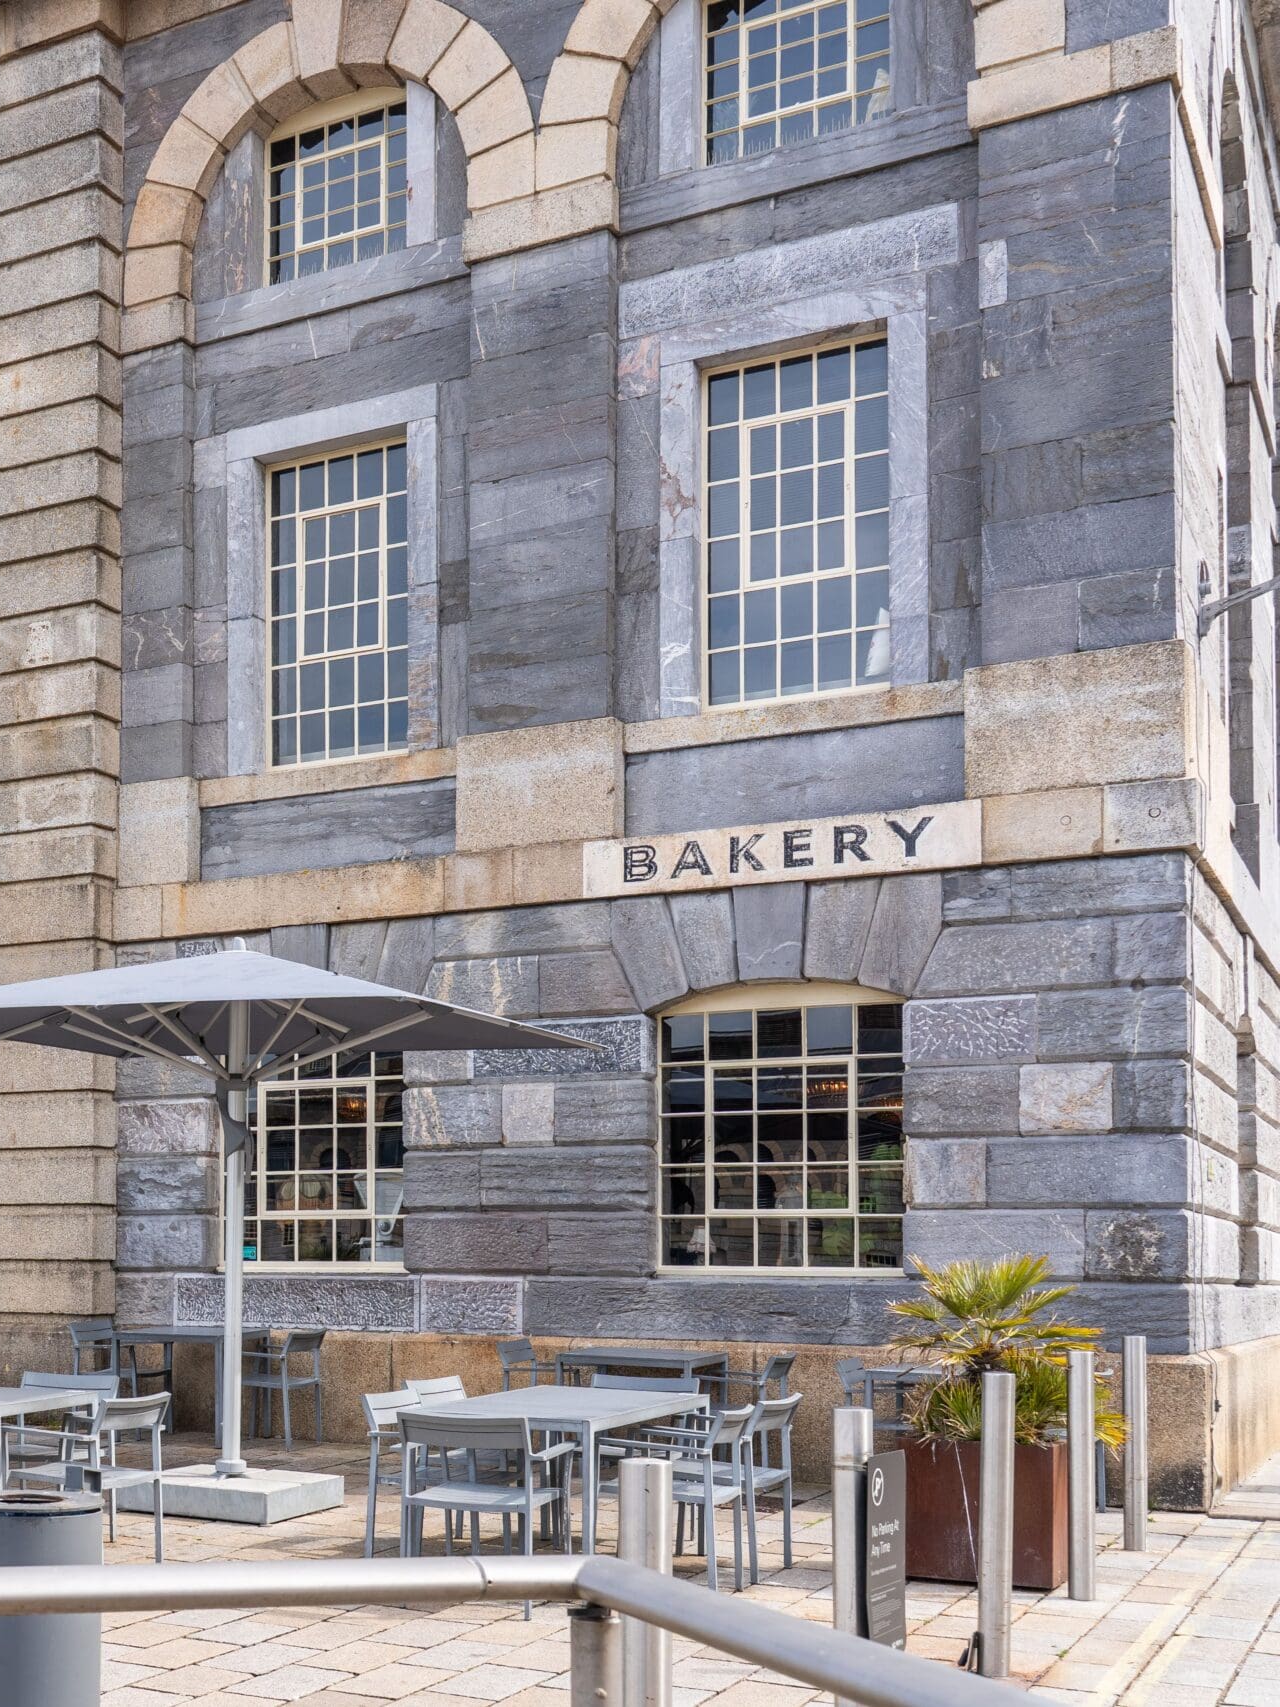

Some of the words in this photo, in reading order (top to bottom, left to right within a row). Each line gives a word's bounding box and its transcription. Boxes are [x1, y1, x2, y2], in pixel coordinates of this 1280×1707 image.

[623, 815, 935, 883] BAKERY
[871, 1525, 878, 1538] No
[879, 1520, 894, 1535] Parking
[894, 1519, 900, 1531] At
[871, 1544, 880, 1558] Any
[880, 1541, 891, 1554] Time
